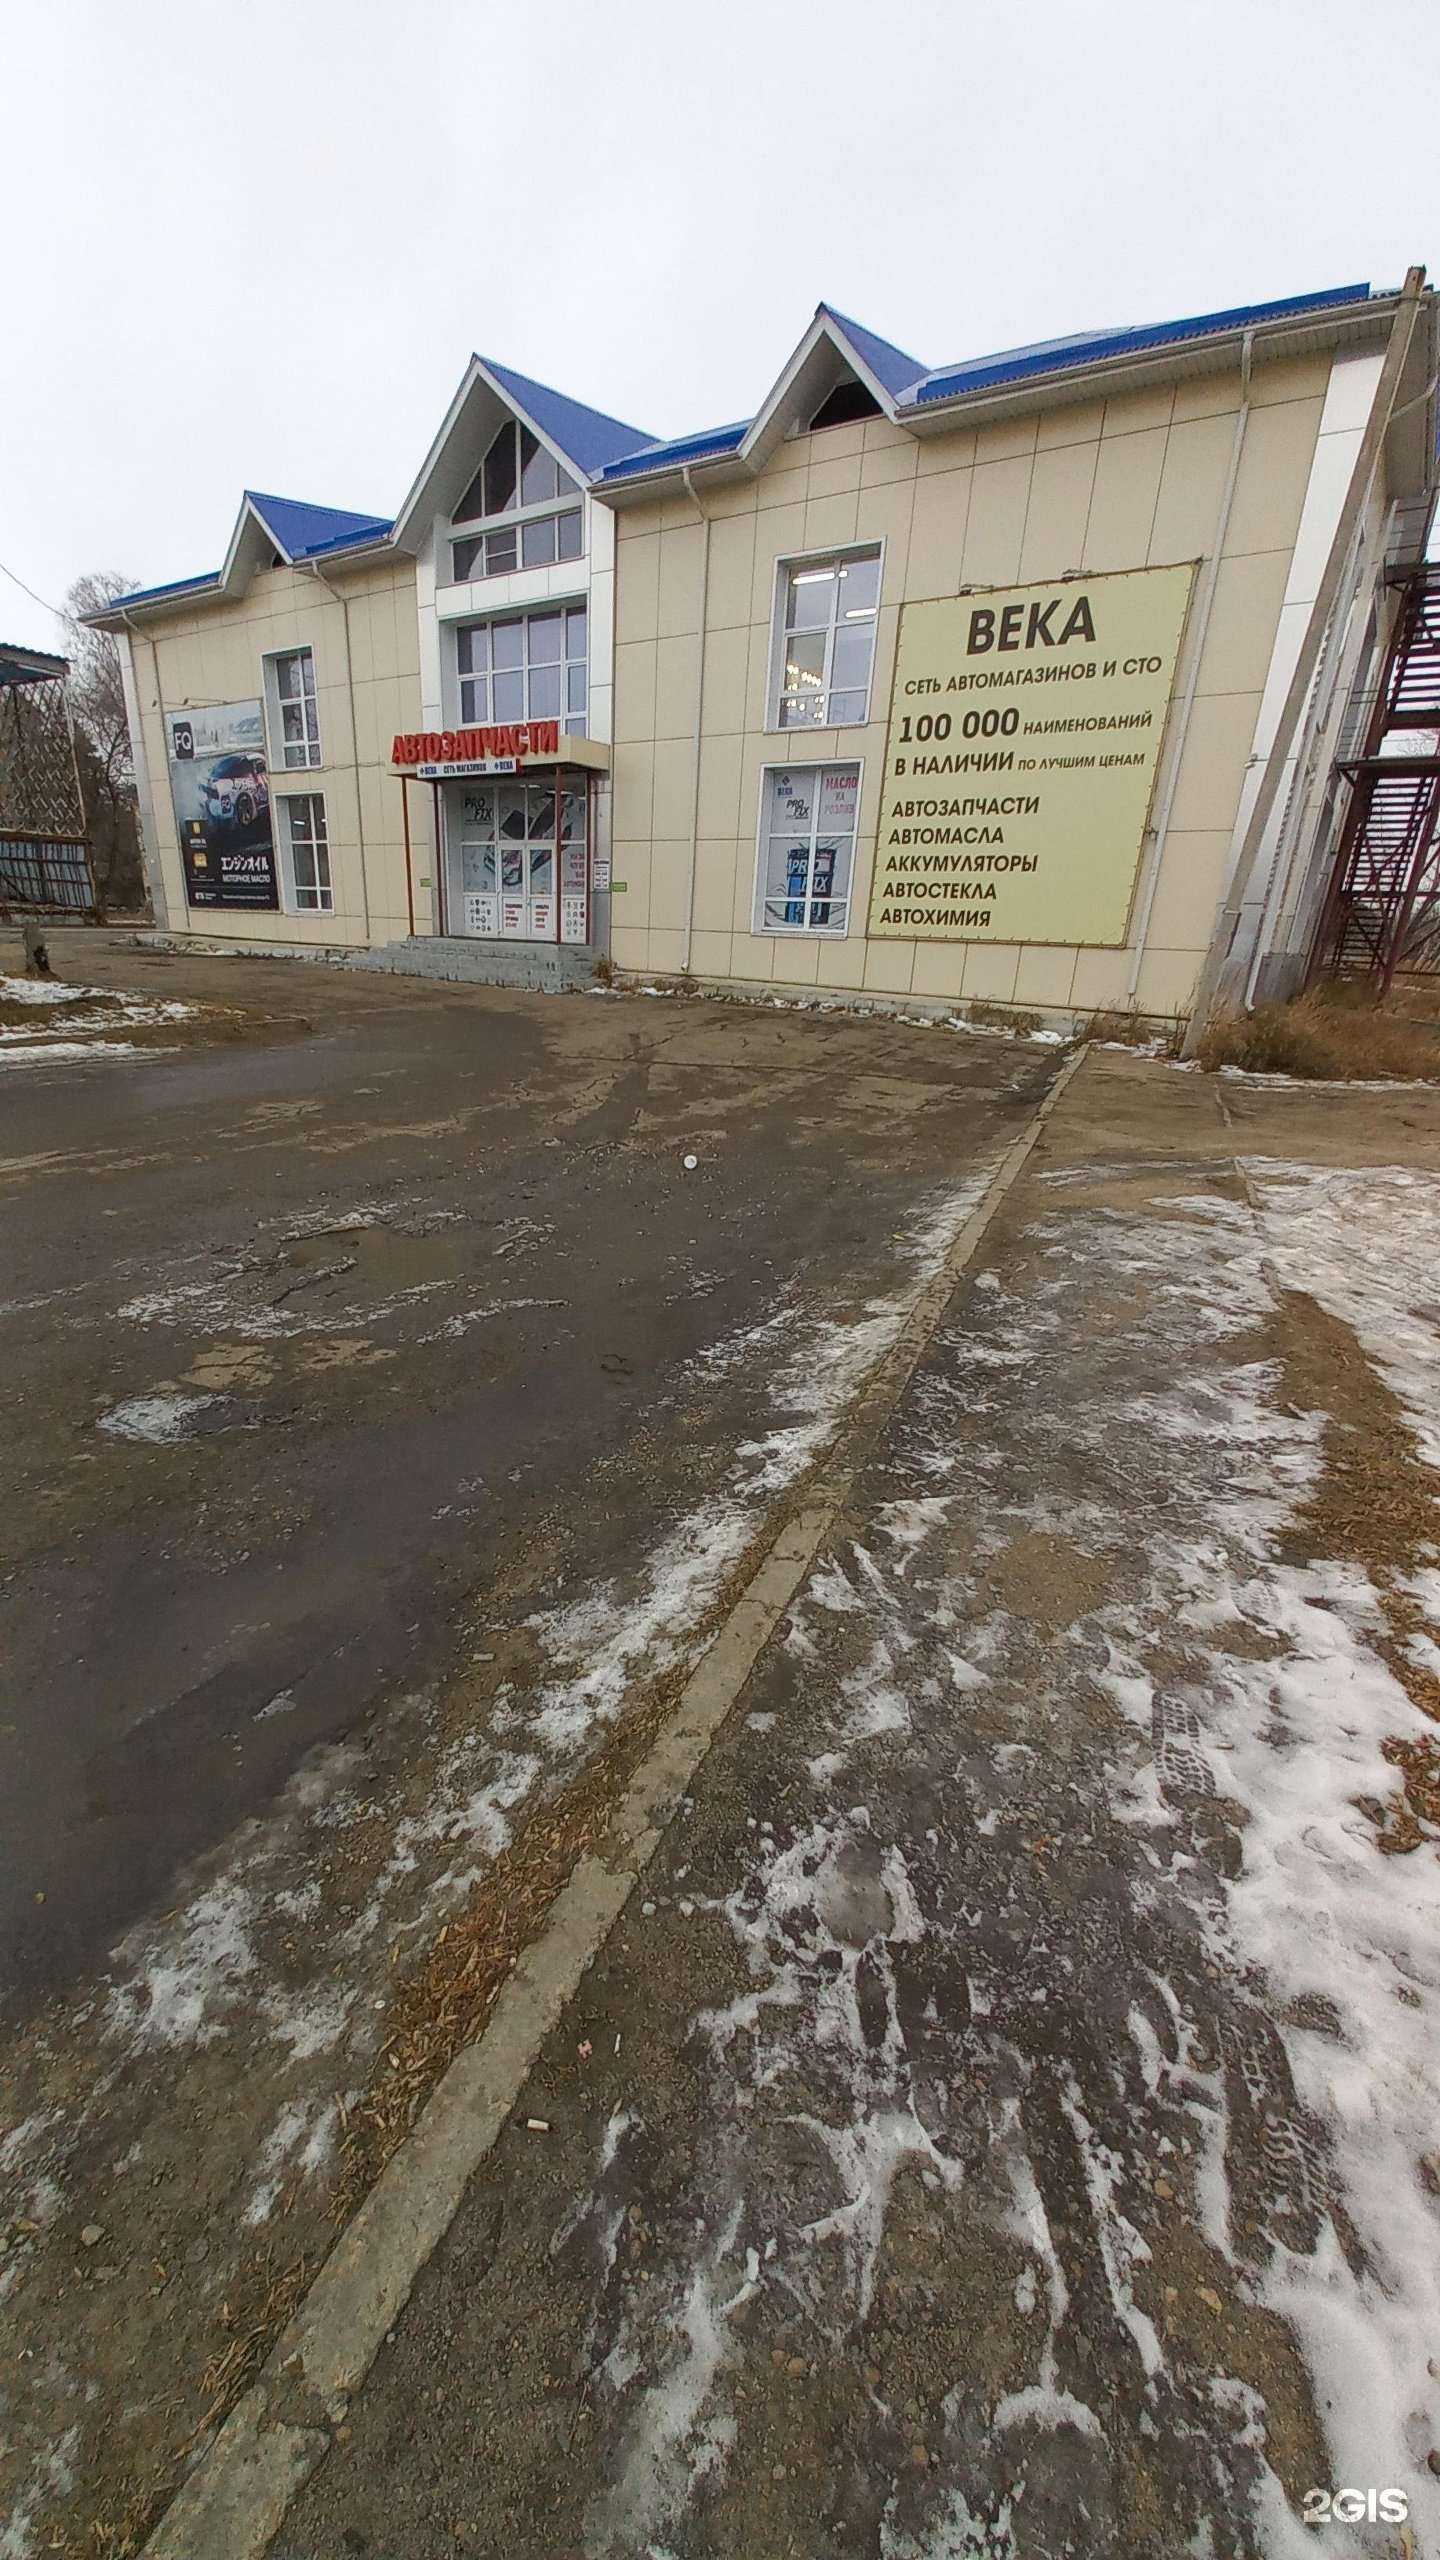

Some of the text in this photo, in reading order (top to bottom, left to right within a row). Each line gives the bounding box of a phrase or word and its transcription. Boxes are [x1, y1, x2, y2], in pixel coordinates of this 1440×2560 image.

[966, 596, 1097, 655] ВЕКА
[904, 656, 1162, 695] СЕТЬ АВТОМАГАЗИНОВ И СТО
[898, 707, 1153, 743] 100 000 НАИМЕНОВАНИЙ
[175, 731, 192, 750] FQ
[391, 720, 559, 764] АВТОЗАПЧАСТИ
[894, 751, 1145, 777] В НАЛИЧИИ ПО ЛУЧШИМ ЦЕНАМ
[825, 775, 858, 791] МАСЛО
[465, 797, 485, 808] PRO
[786, 799, 804, 809] PRO
[793, 806, 810, 817] FIX
[891, 796, 1040, 818] АВТОЗАПЧАСТИ
[474, 807, 492, 821] FIX
[888, 826, 1004, 845] АВТОМАСЛА
[885, 854, 1038, 873] АККУМУЛЯТОРЫ
[882, 882, 997, 900] АВТОСТЕКЛА
[879, 908, 991, 927] АВТОХИМИЯ
